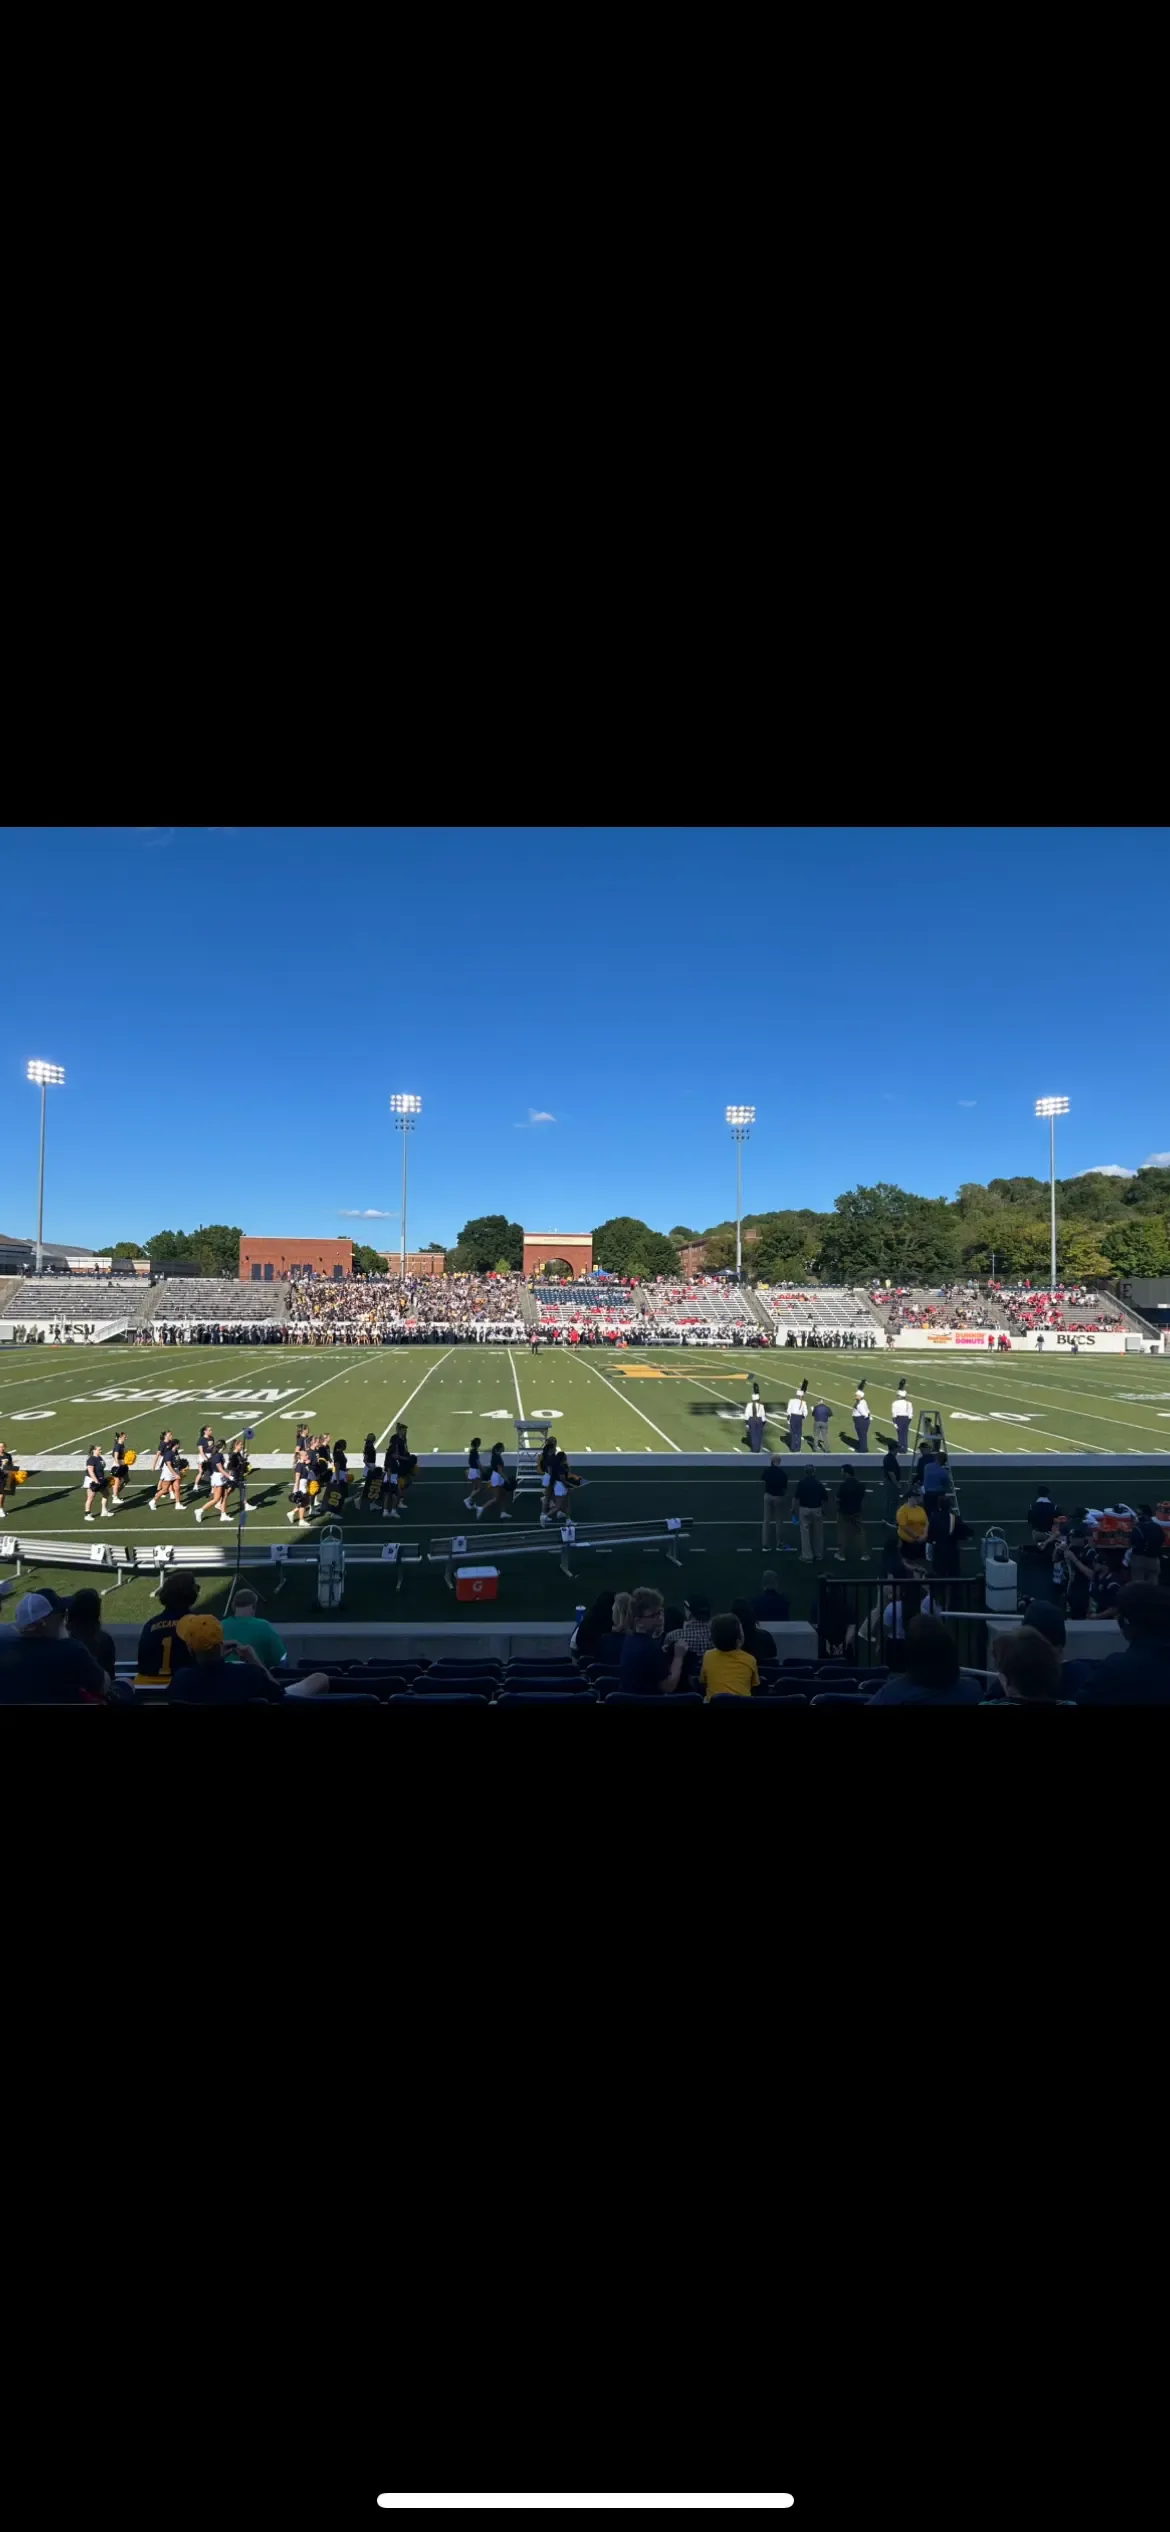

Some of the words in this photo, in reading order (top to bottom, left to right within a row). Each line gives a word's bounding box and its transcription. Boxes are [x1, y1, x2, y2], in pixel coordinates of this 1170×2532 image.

[1057, 1334, 1096, 1346] BUCS
[367, 1479, 383, 1501] UCS
[472, 1581, 484, 1592] G
[158, 1636, 173, 1675] 1
